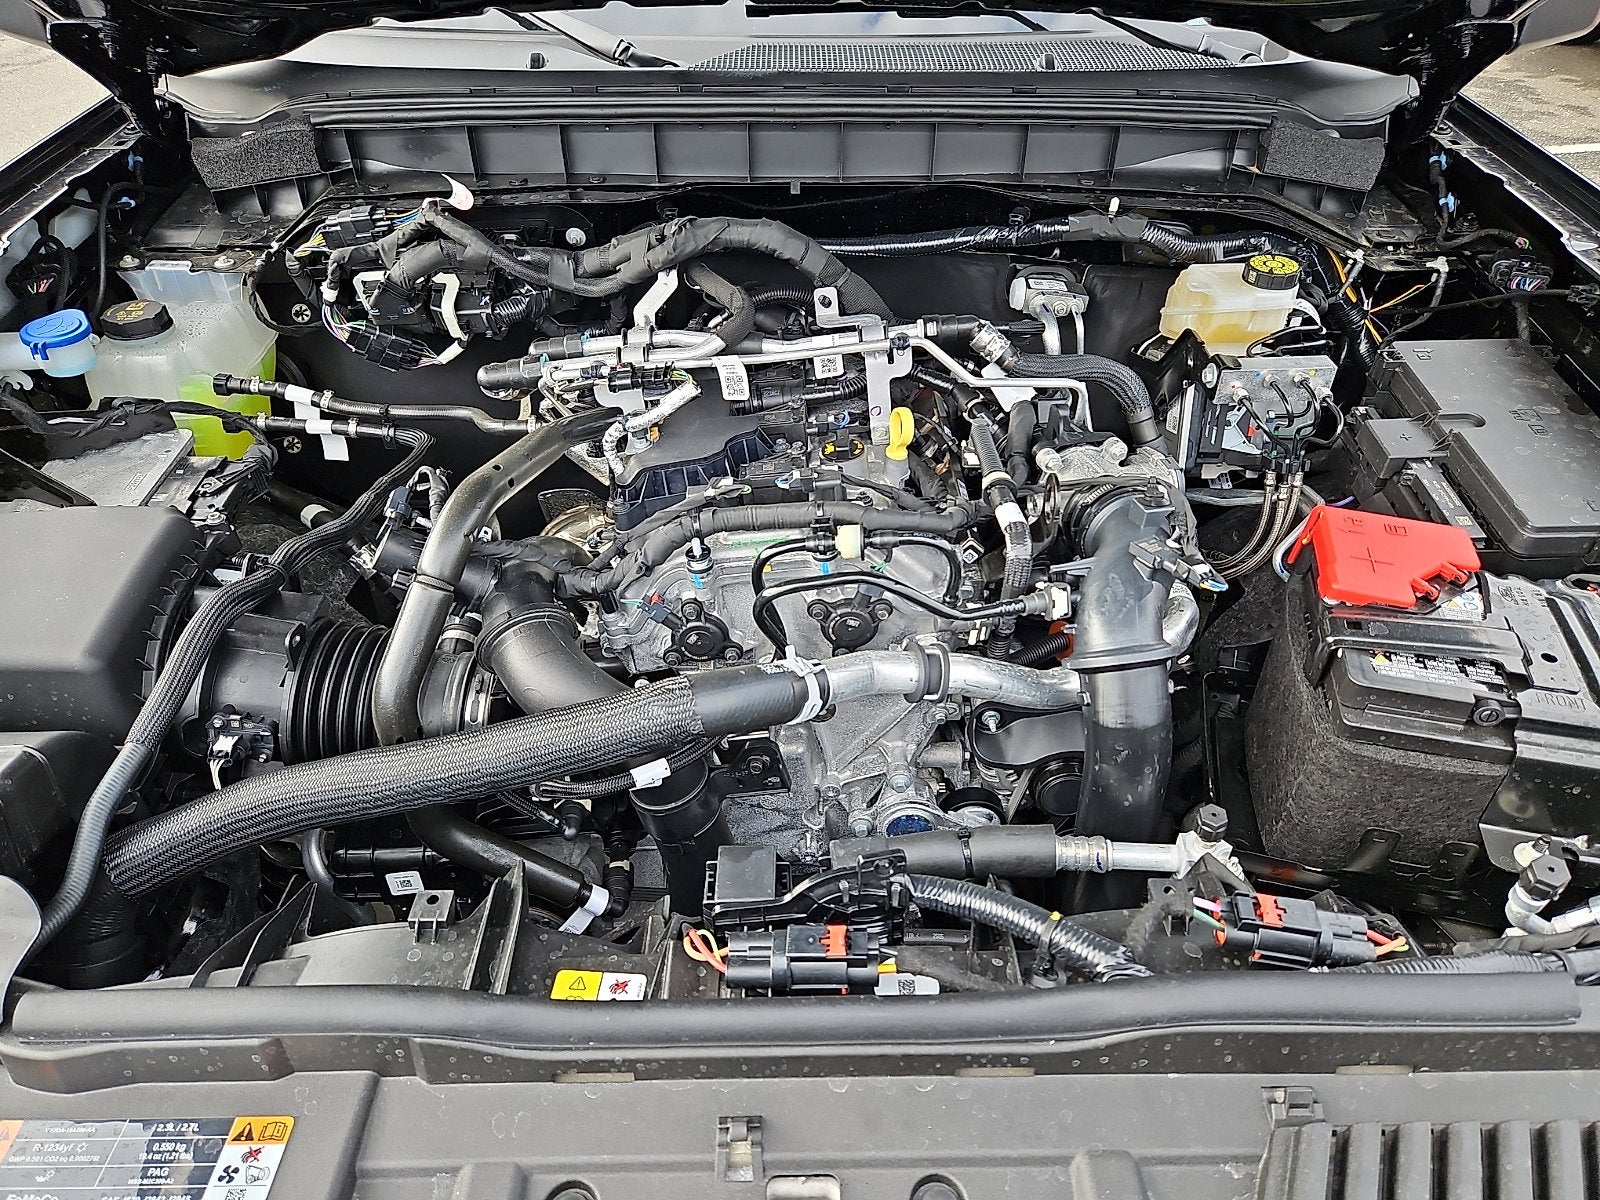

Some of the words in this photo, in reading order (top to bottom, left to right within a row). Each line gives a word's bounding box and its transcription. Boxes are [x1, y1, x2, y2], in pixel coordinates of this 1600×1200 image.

[32, 1143, 75, 1154] R-1234yf
[152, 1142, 175, 1152] 0.550
[175, 1142, 187, 1153] kg
[147, 1167, 170, 1177] PAG
